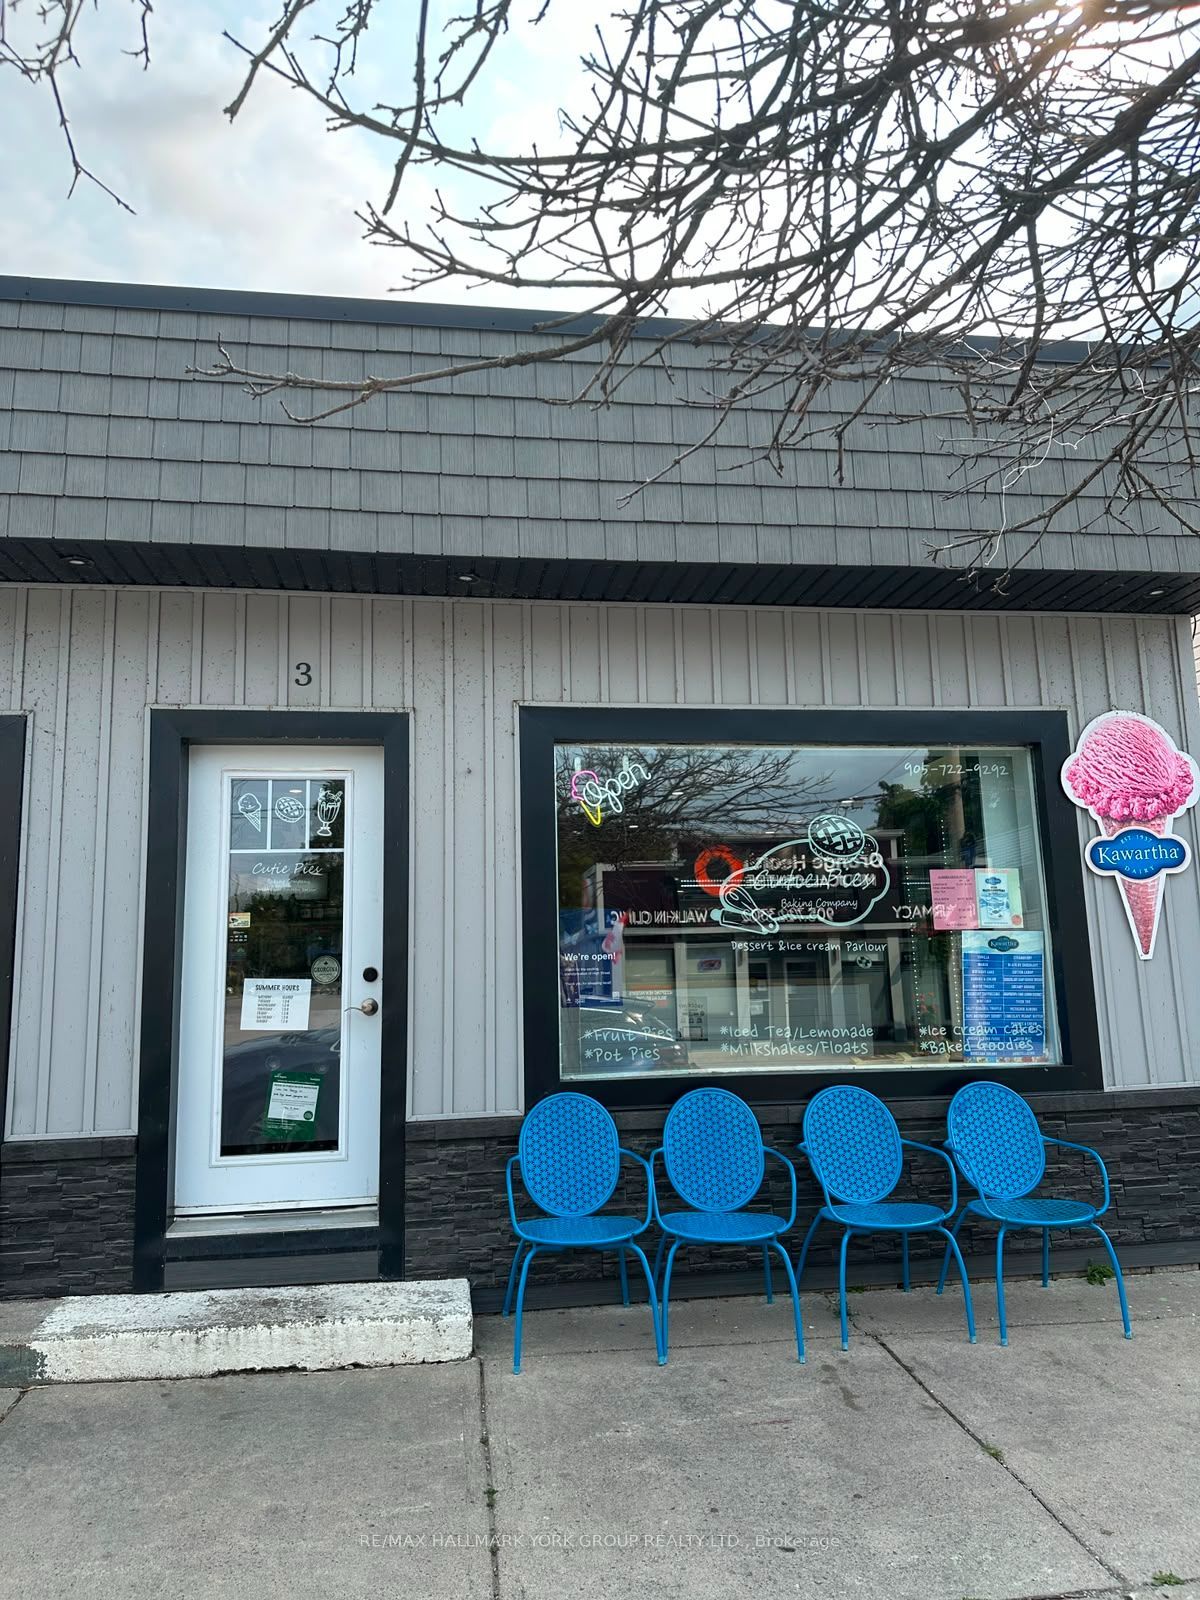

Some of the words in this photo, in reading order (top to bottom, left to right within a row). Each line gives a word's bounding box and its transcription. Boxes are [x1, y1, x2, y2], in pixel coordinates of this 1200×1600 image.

[295, 662, 312, 687] 3
[904, 763, 1009, 777] 905-722-9292
[583, 763, 651, 813] Open
[1098, 845, 1179, 865] Kawartha
[251, 862, 290, 875] Cutie
[293, 862, 324, 876] Pies
[1124, 865, 1155, 875] DAIRY
[780, 897, 813, 908] Baking
[815, 898, 858, 910] Company
[731, 940, 775, 951] Dessert
[806, 942, 841, 952] cream
[845, 941, 888, 952] Parlour
[564, 952, 590, 961] We're
[591, 952, 616, 962] open!
[764, 1023, 874, 1041] Tea/Lemonade
[977, 1037, 1034, 1052] Goodies
[631, 1046, 661, 1061] Pies
